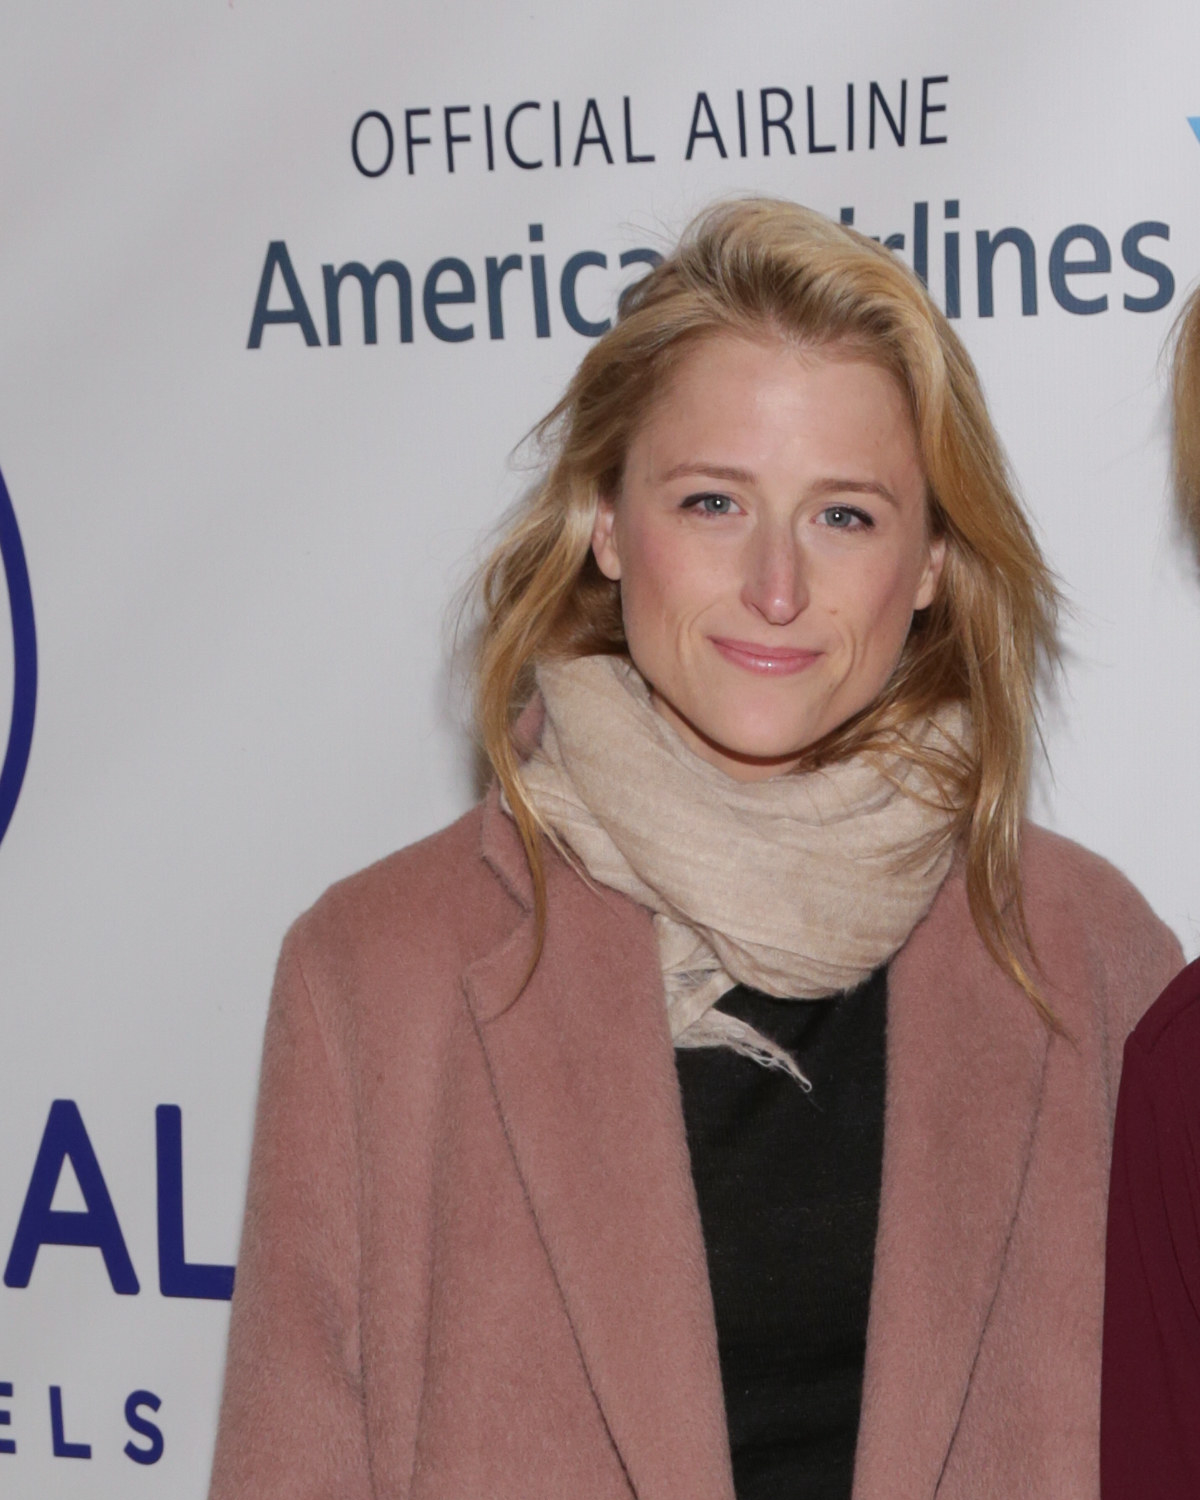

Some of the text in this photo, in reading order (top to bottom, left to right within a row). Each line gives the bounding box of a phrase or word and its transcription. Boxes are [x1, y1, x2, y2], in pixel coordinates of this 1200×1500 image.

[350, 75, 950, 178] OFFICIAL AIRLINE
[840, 199, 1176, 319] lines
